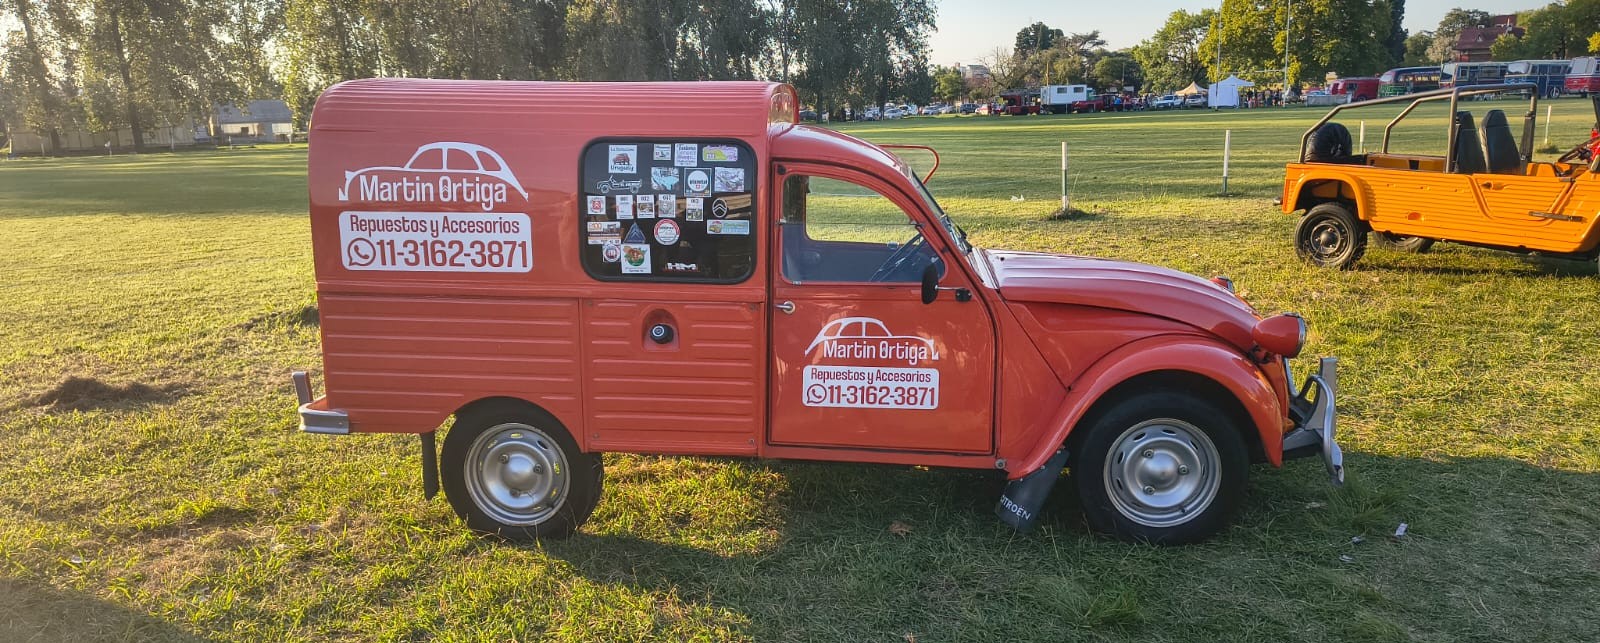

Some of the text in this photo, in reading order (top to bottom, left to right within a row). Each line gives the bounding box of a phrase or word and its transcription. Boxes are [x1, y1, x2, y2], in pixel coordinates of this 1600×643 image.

[359, 175, 507, 211] Martin Ortiga
[350, 214, 520, 238] Repuestos y Accesorios
[376, 239, 528, 268] 11-3162-3871
[823, 340, 928, 366] Martin Ortiga
[811, 367, 931, 384] Repuestos y Accesorios
[828, 385, 935, 406] 11-3162-3871
